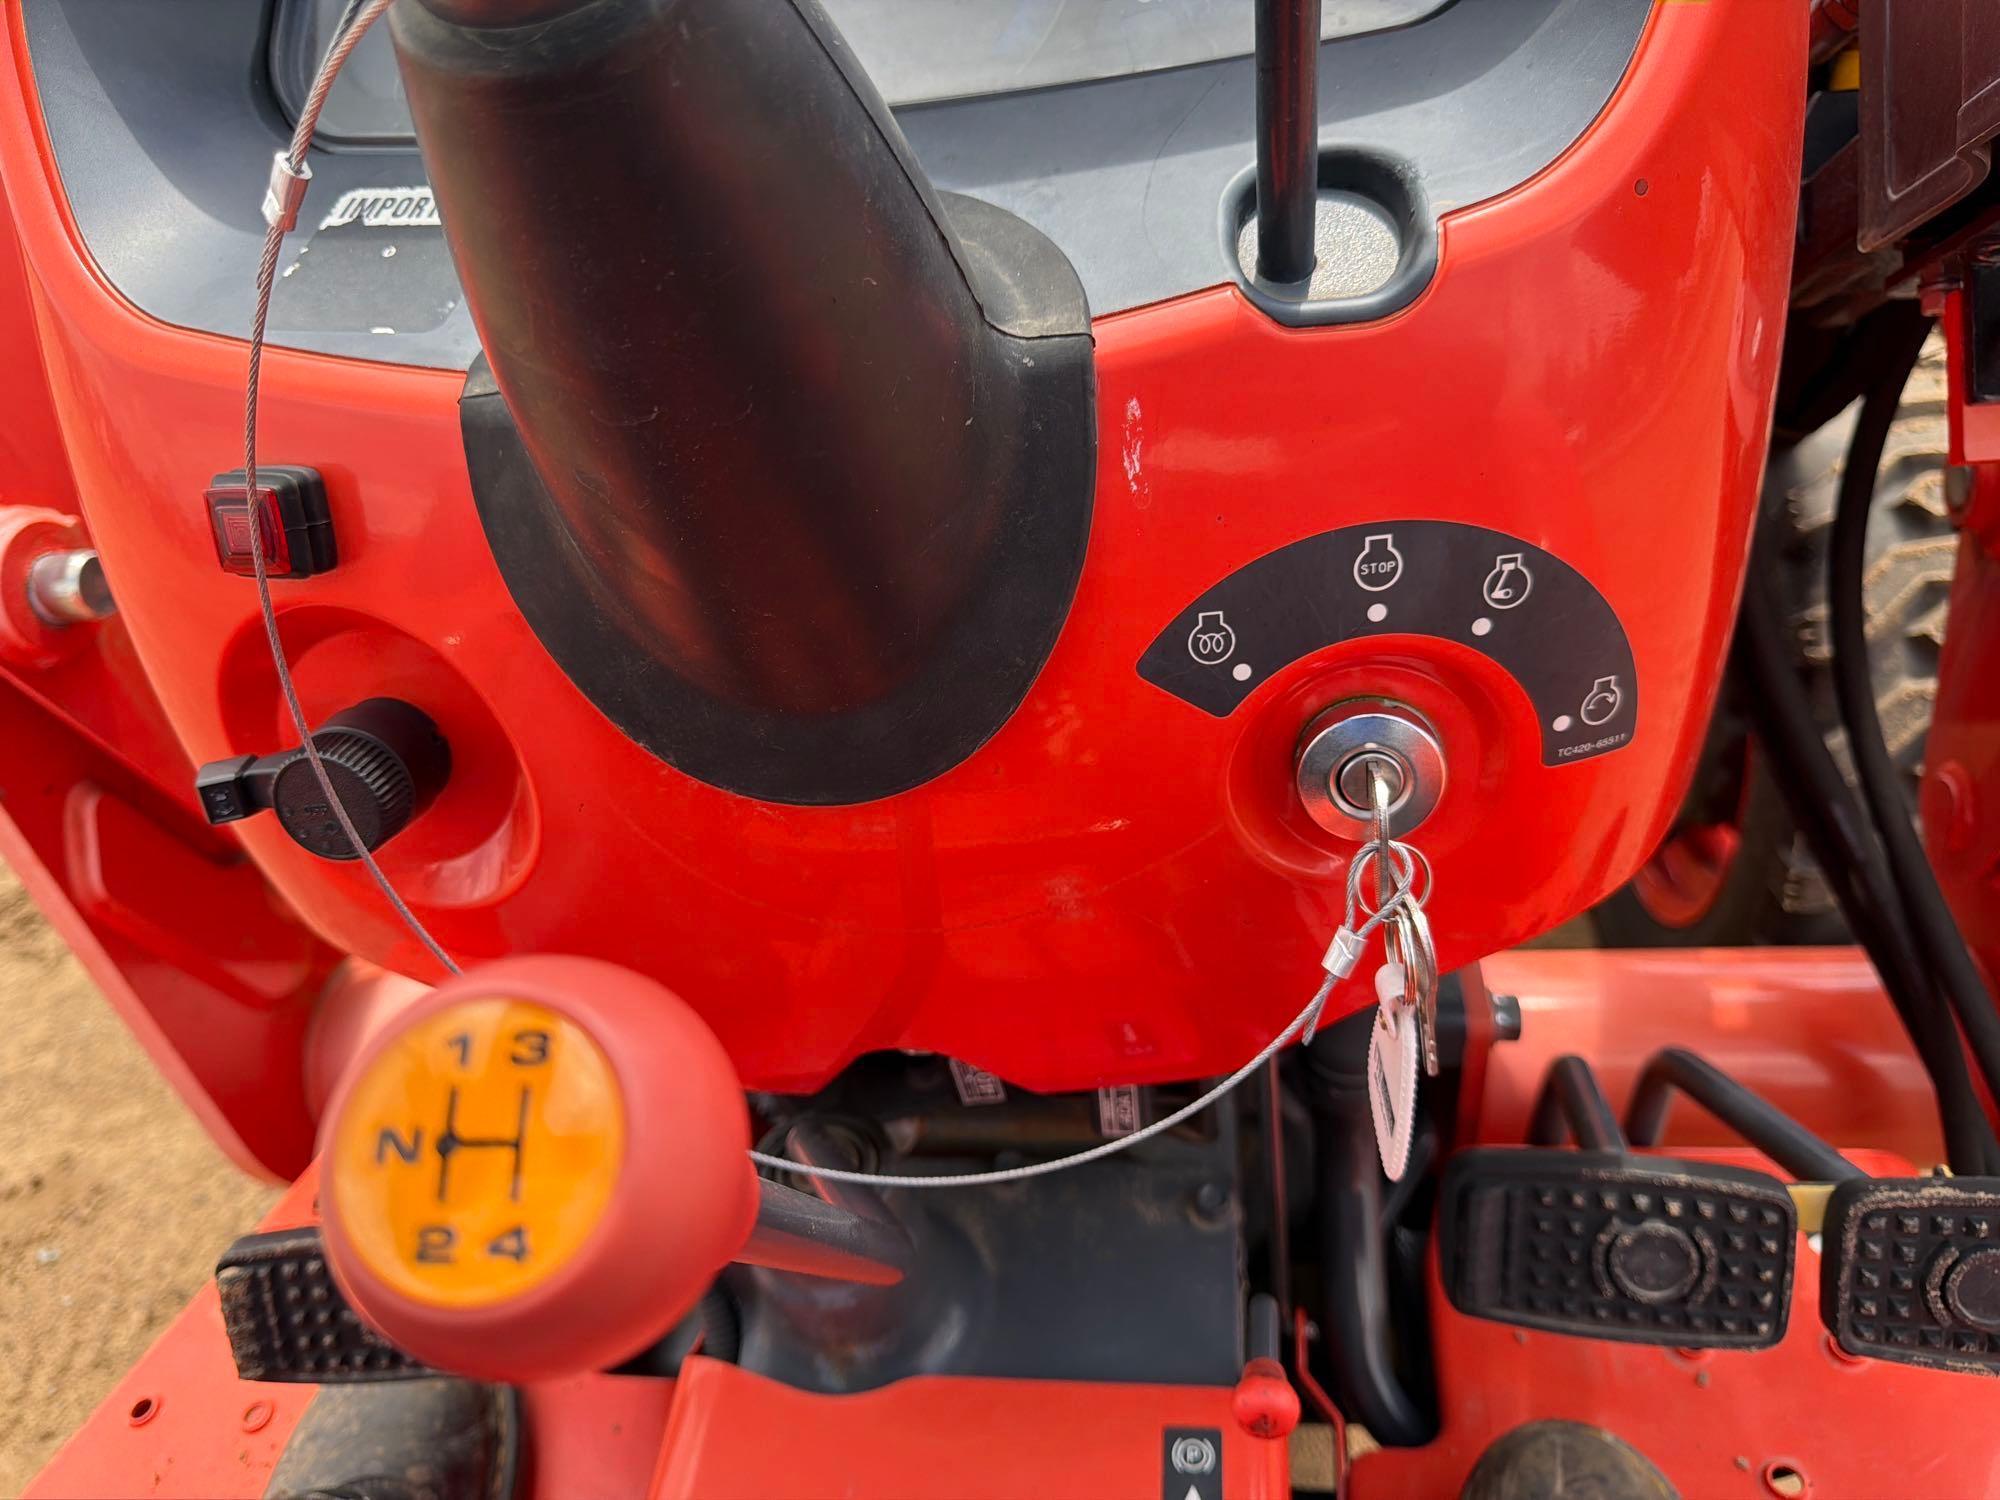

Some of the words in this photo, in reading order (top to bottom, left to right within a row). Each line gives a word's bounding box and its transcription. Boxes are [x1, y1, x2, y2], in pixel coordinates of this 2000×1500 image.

[1360, 560, 1396, 576] STOP
[448, 1031, 471, 1067] 1
[510, 1029, 550, 1067] 3
[375, 1125, 424, 1165] N
[415, 1225, 455, 1264] 2
[488, 1225, 529, 1263] 4
